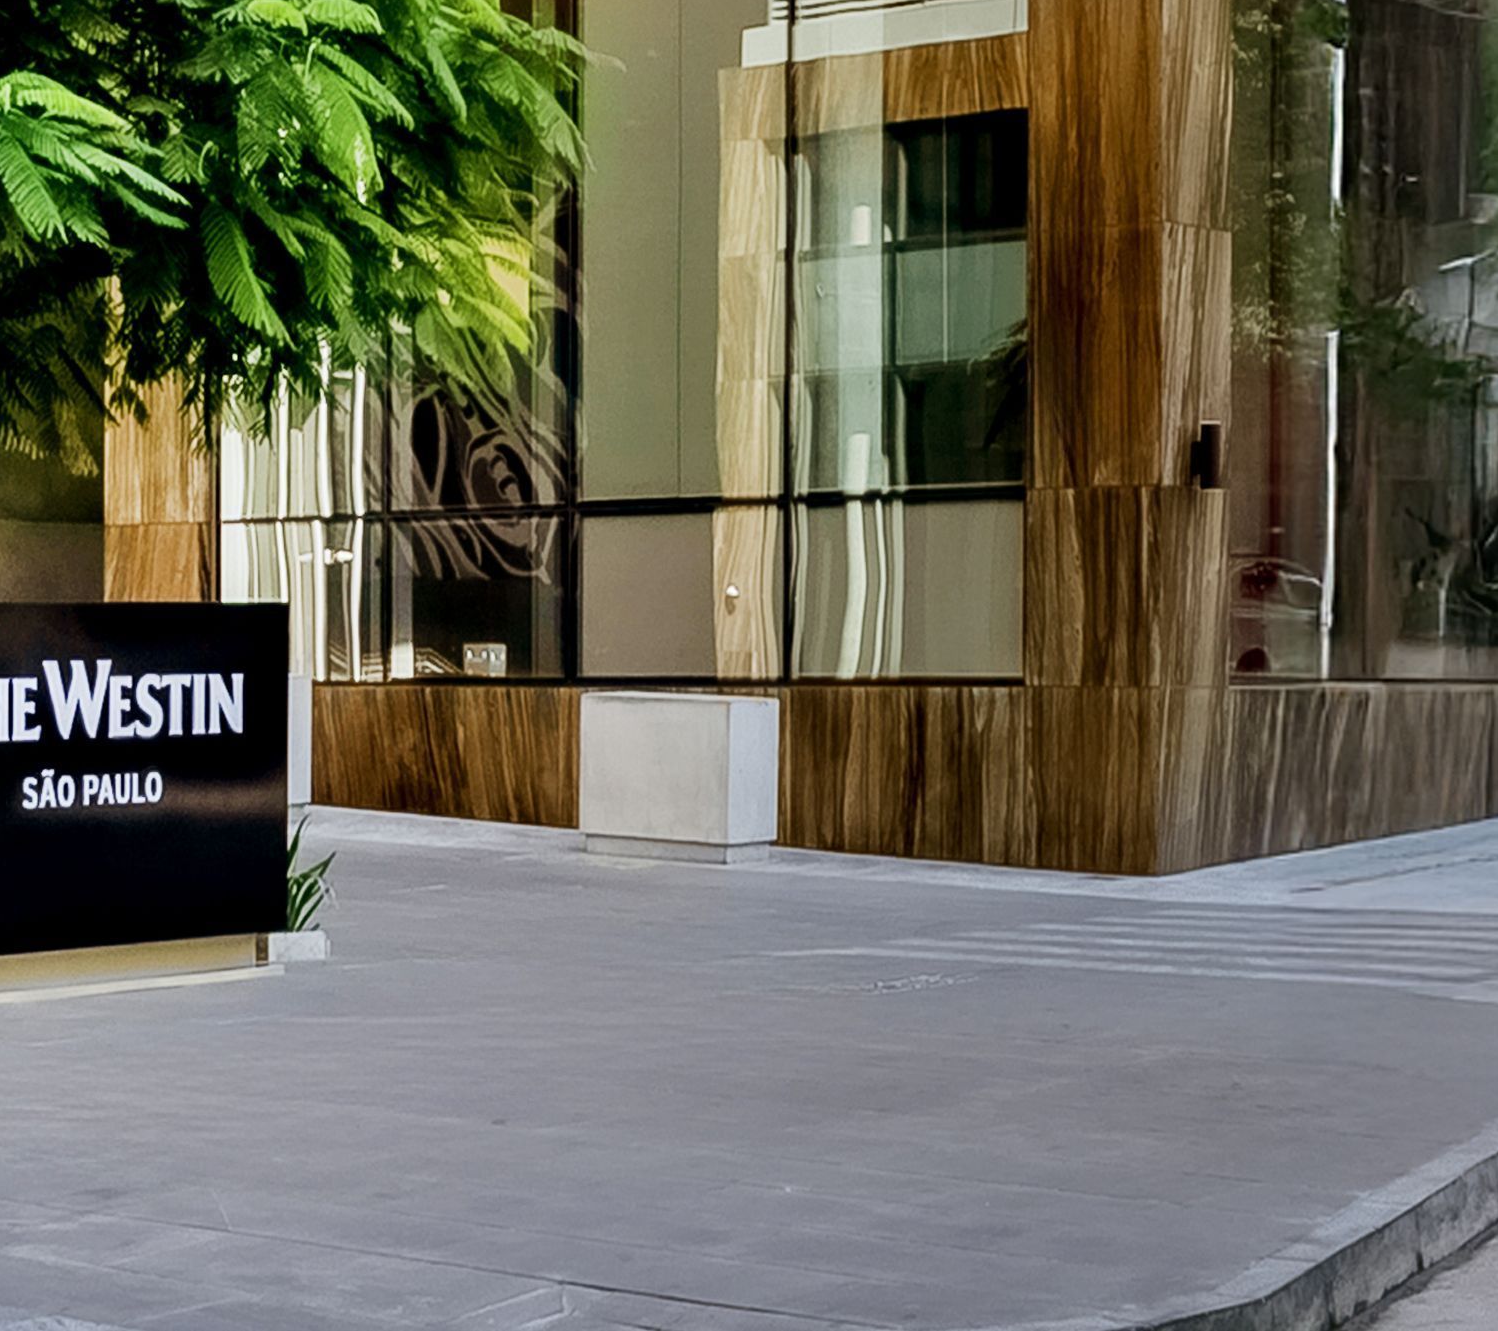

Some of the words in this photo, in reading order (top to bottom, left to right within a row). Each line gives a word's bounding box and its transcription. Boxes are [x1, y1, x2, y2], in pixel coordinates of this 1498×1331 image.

[42, 659, 245, 739] WESTIN
[21, 769, 76, 810] SÃO
[81, 771, 164, 807] PAULO
